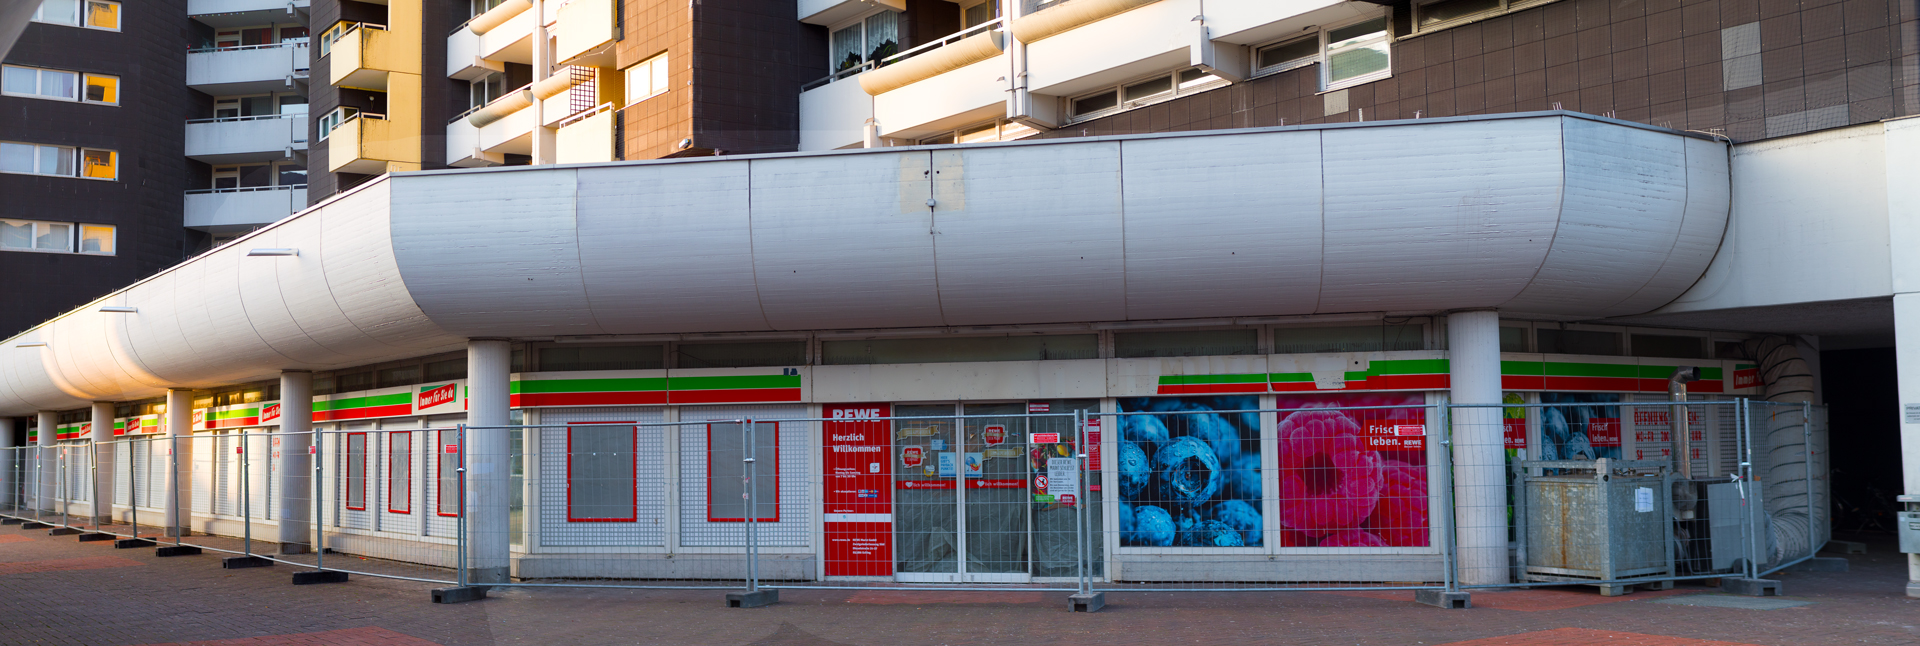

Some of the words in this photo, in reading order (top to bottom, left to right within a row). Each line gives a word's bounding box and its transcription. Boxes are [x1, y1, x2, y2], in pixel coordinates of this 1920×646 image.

[1735, 374, 1755, 386] Immer
[419, 395, 433, 407] Immer
[440, 388, 448, 401] Sie
[447, 386, 454, 398] da
[832, 408, 881, 422] REWE
[1369, 424, 1394, 434] Frisc
[1591, 423, 1608, 431] Frisch
[832, 433, 865, 441] Herzlich
[1369, 436, 1401, 446] leben.
[1591, 433, 1609, 443] leben.
[832, 444, 881, 453] Willkommen
